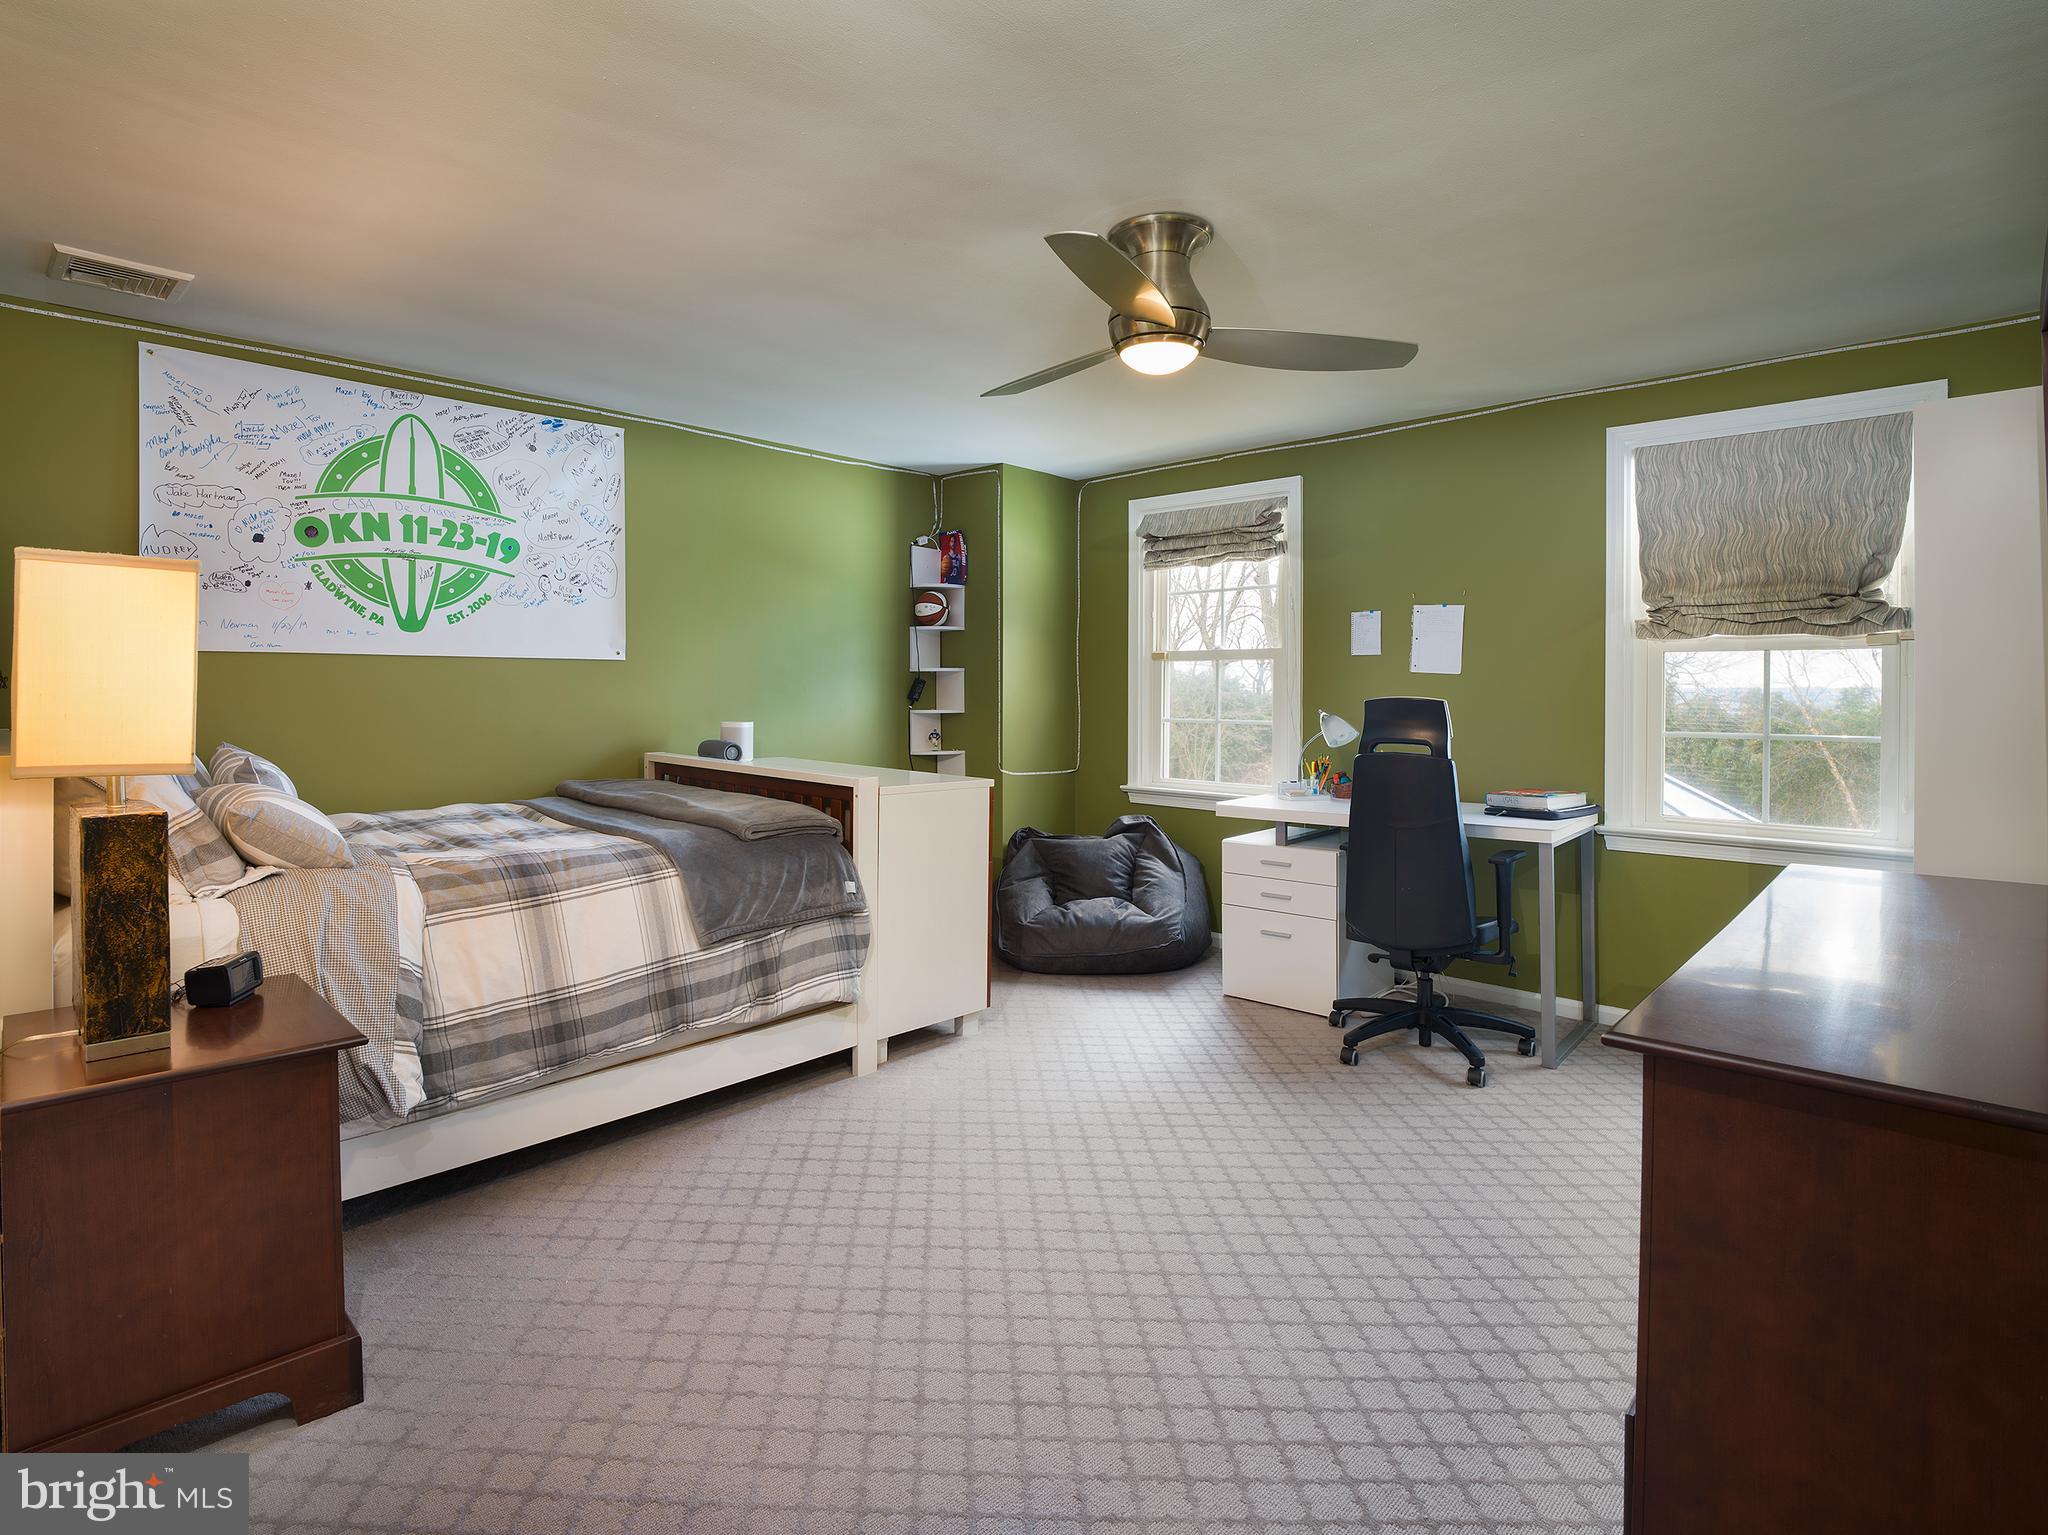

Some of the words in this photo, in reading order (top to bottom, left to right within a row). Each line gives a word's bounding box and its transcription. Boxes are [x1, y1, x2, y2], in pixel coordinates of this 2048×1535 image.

[166, 486, 192, 498] Jake
[196, 488, 237, 501] Hartman
[142, 544, 192, 556] AUDREY
[293, 511, 391, 548] OKN
[399, 513, 521, 565] 11-23-19
[310, 563, 368, 619] GLADWYNE,
[369, 611, 385, 626] PA
[446, 608, 470, 626] EST.
[469, 592, 493, 614] 2006
